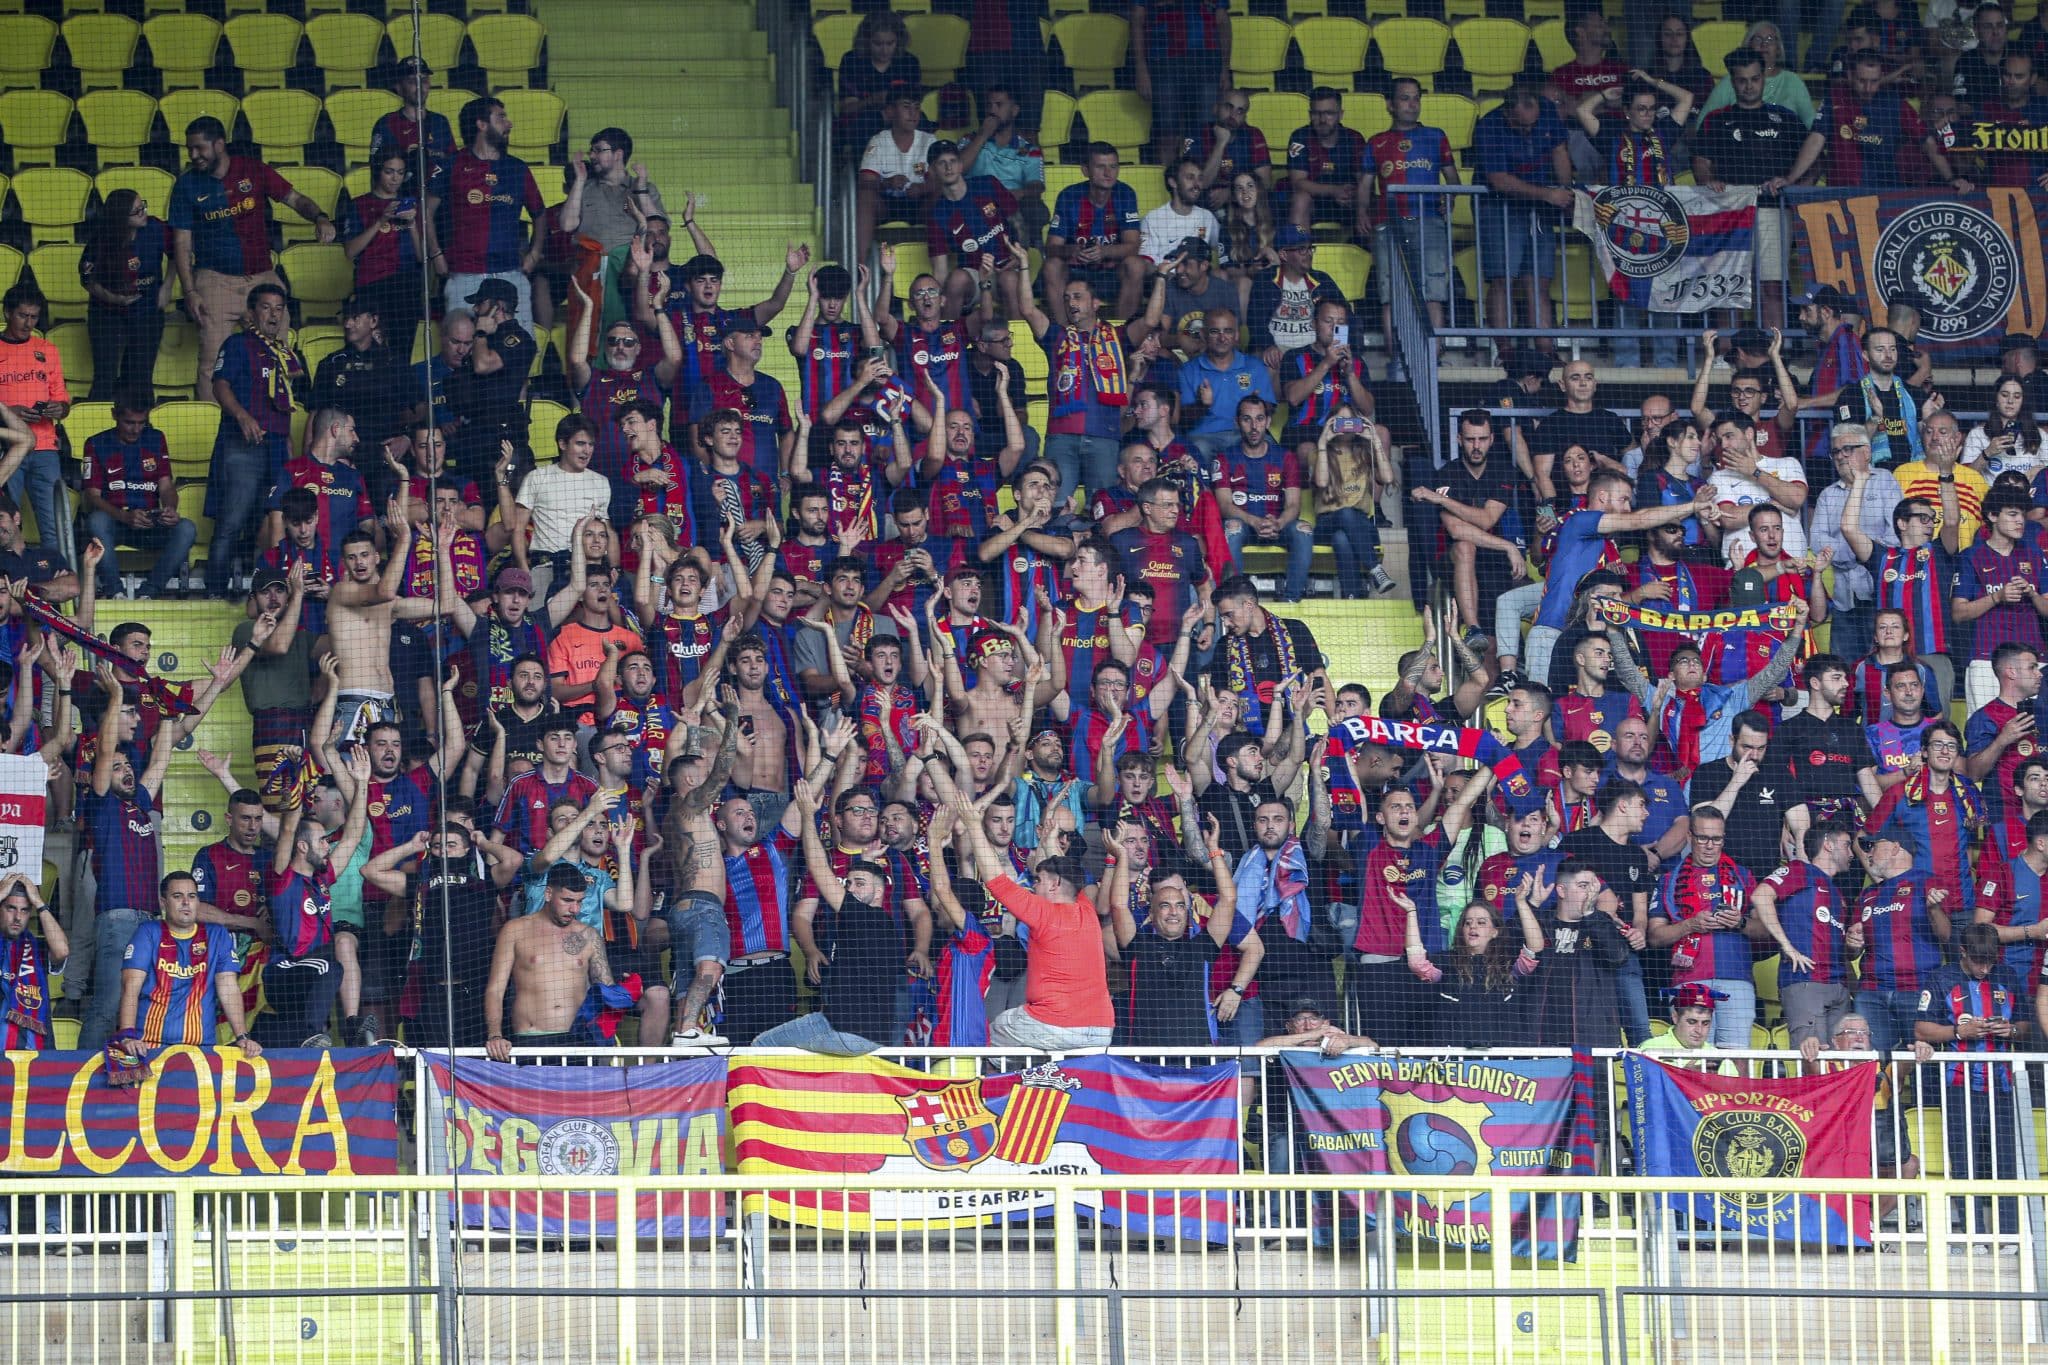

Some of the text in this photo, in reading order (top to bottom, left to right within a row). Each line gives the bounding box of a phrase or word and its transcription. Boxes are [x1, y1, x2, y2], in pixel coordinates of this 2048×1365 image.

[1574, 73, 1618, 87] adidas
[1395, 158, 1433, 171] Spotify
[484, 193, 514, 205] Spotify
[204, 204, 243, 222] unicef
[977, 222, 1005, 247] Spotify
[1884, 212, 2008, 311] OT-BALL CLUB BARCELONA
[1931, 315, 1969, 333] 1899
[0, 369, 35, 386] unicef
[743, 411, 774, 425] Spotify
[127, 480, 158, 493] Spotify
[321, 485, 353, 498] Spotify
[1138, 568, 1181, 580] Foundation
[1148, 561, 1174, 573] Qatar
[1640, 608, 1761, 632] BARÇA
[669, 640, 712, 659] akuten
[162, 654, 176, 666] 10
[1344, 717, 1460, 752] BARÇA
[197, 813, 206, 825] 8
[1400, 868, 1426, 883] Spotify
[1872, 902, 1906, 916] Spotify
[158, 958, 208, 979] Rakuten
[1328, 1061, 1539, 1106] PENYA BARCELONISTA
[1725, 1112, 1762, 1126] CLUB
[561, 1122, 587, 1133] CLUB
[590, 1126, 614, 1175] BARCELON
[1308, 1132, 1379, 1152] CABANYAL
[1500, 1149, 1546, 1168] CIUTAT
[938, 1196, 963, 1209] DE
[302, 1320, 311, 1332] 2
[1523, 1314, 1533, 1327] 2
